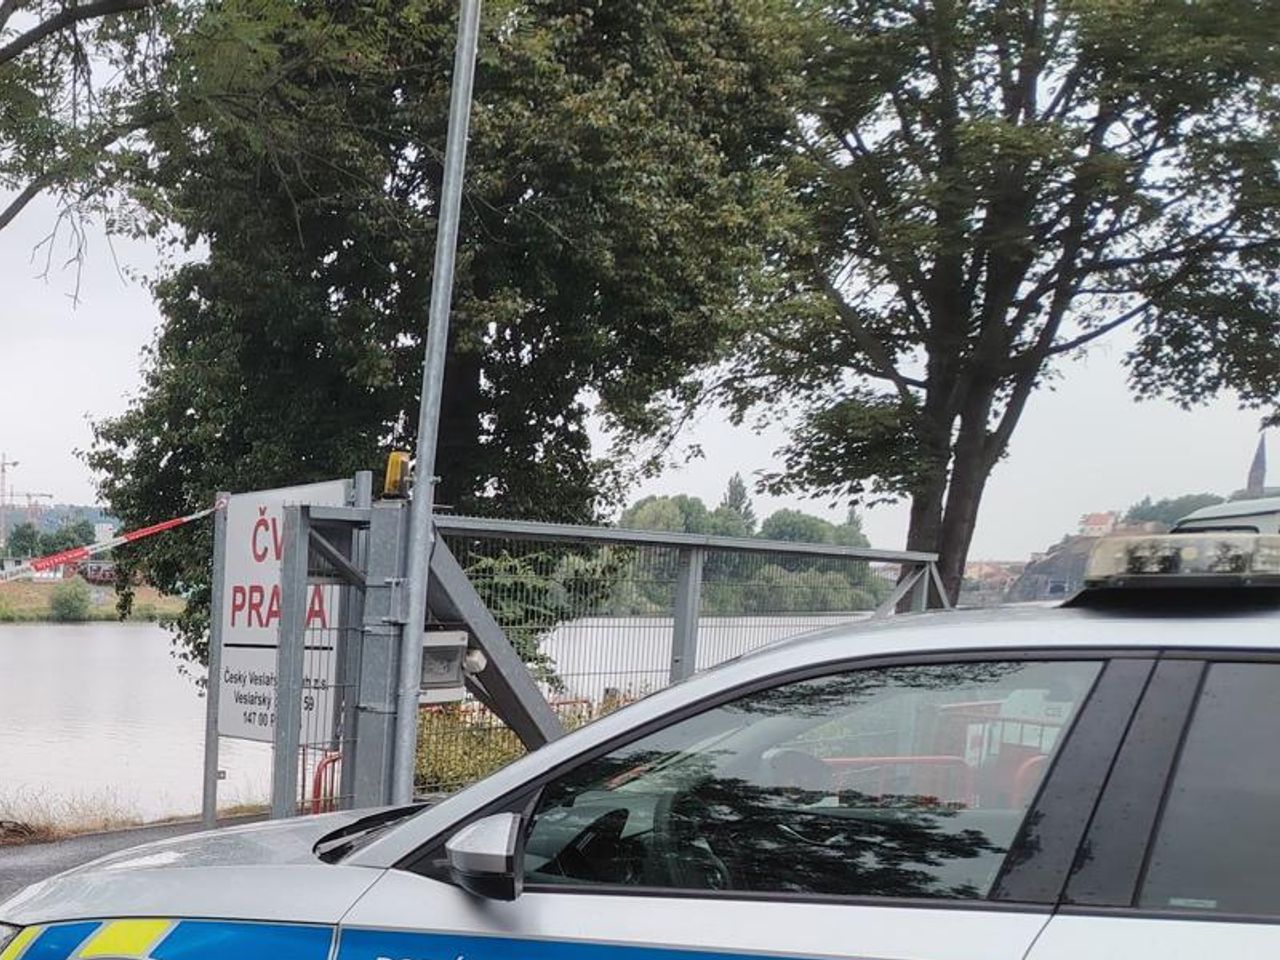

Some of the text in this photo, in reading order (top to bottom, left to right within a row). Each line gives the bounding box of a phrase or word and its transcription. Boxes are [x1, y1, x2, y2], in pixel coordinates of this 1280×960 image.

[252, 506, 283, 562] ČV
[230, 584, 328, 629] PRAA
[224, 667, 247, 687] Český
[234, 689, 272, 710] Veslařský
